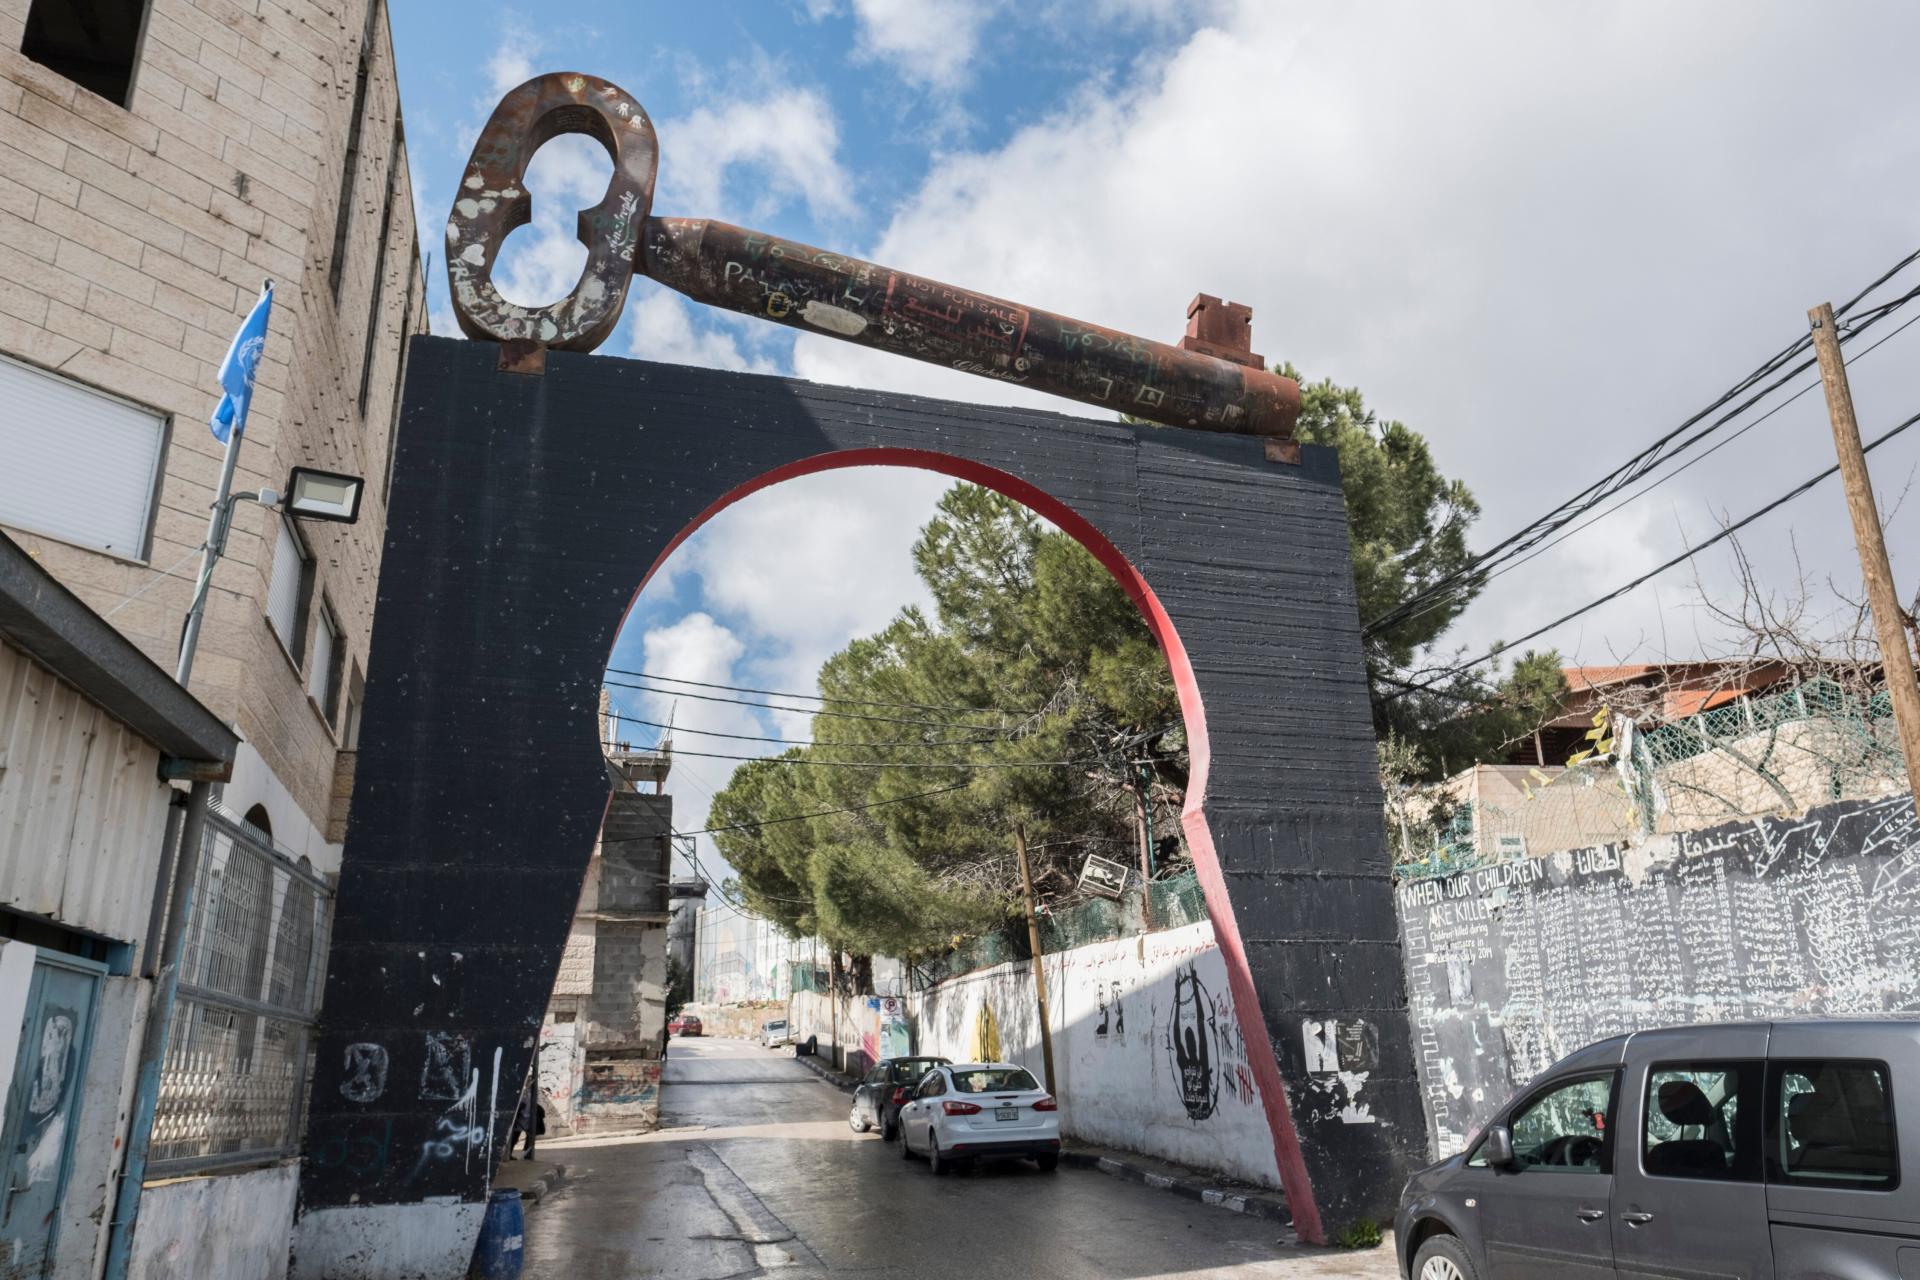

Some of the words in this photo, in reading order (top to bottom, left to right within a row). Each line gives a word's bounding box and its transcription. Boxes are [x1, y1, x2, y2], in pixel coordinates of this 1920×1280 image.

[906, 277, 937, 294] NOT
[943, 290, 974, 309] FOR
[980, 302, 1018, 324] SALE
[1885, 810, 1915, 833] U.S.A
[1400, 880, 1443, 909] WHEN
[1446, 875, 1472, 899] OUR
[1476, 858, 1543, 892] CHILDREN
[1428, 903, 1453, 929] ARE
